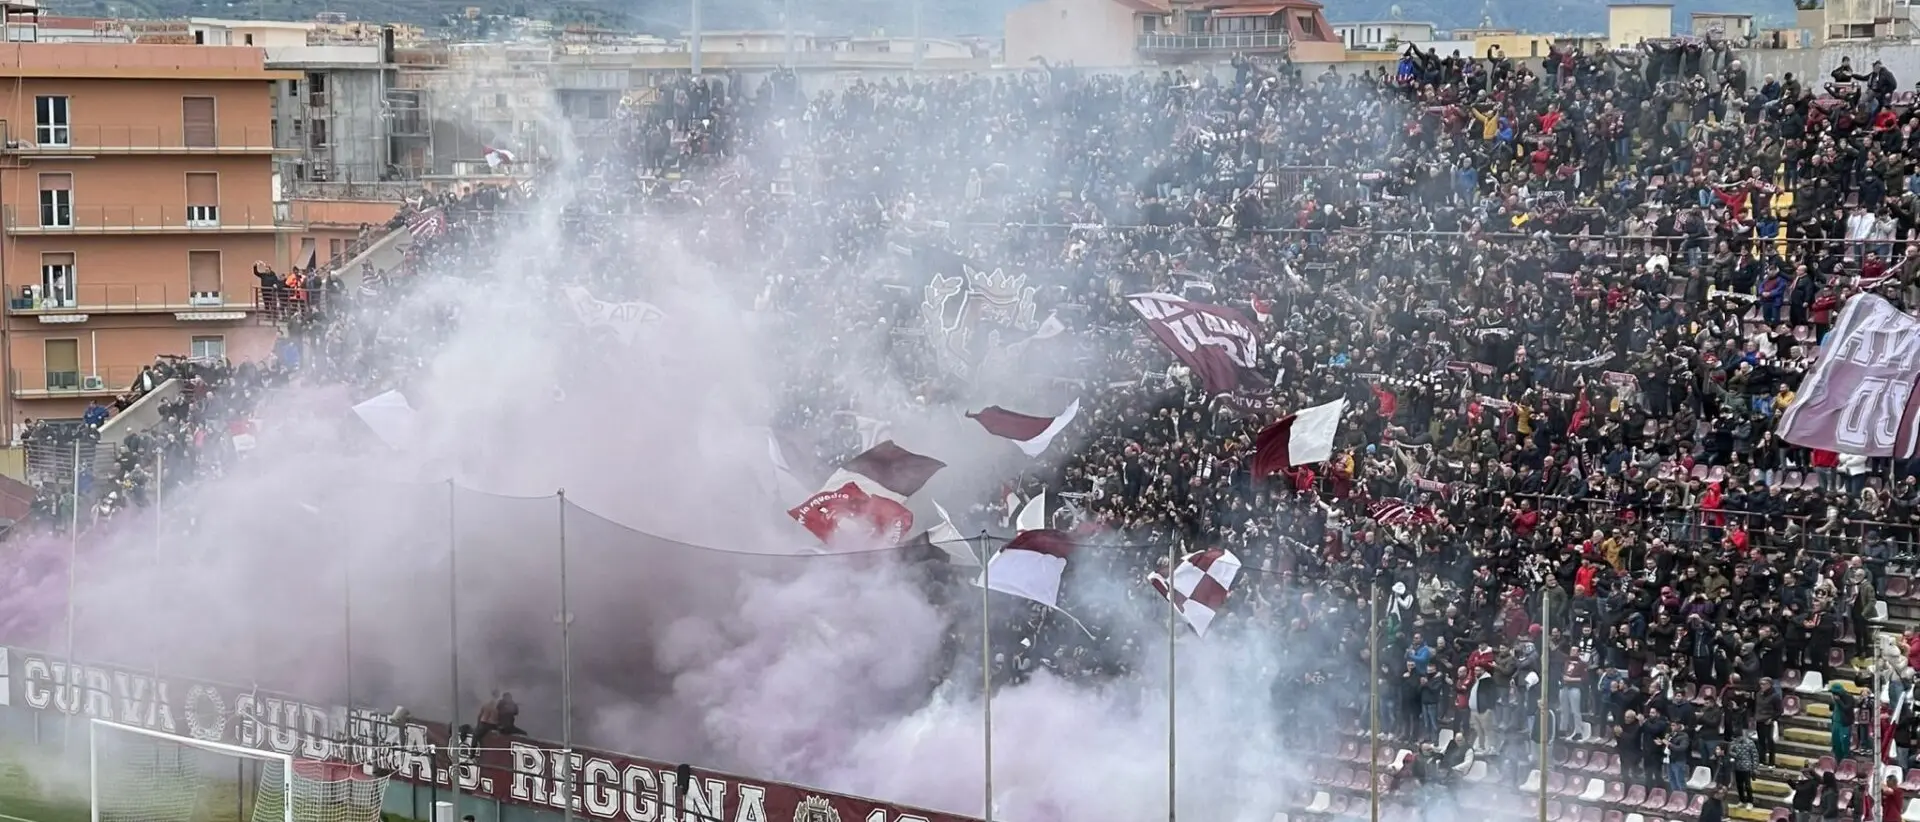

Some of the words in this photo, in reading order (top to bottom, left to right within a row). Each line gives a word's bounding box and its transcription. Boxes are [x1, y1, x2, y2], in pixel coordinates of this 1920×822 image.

[1231, 390, 1262, 409] urva
[24, 655, 177, 733] CURVA
[234, 692, 332, 762] SUD
[400, 722, 494, 795] A.S.
[510, 740, 768, 822] REGGINA
